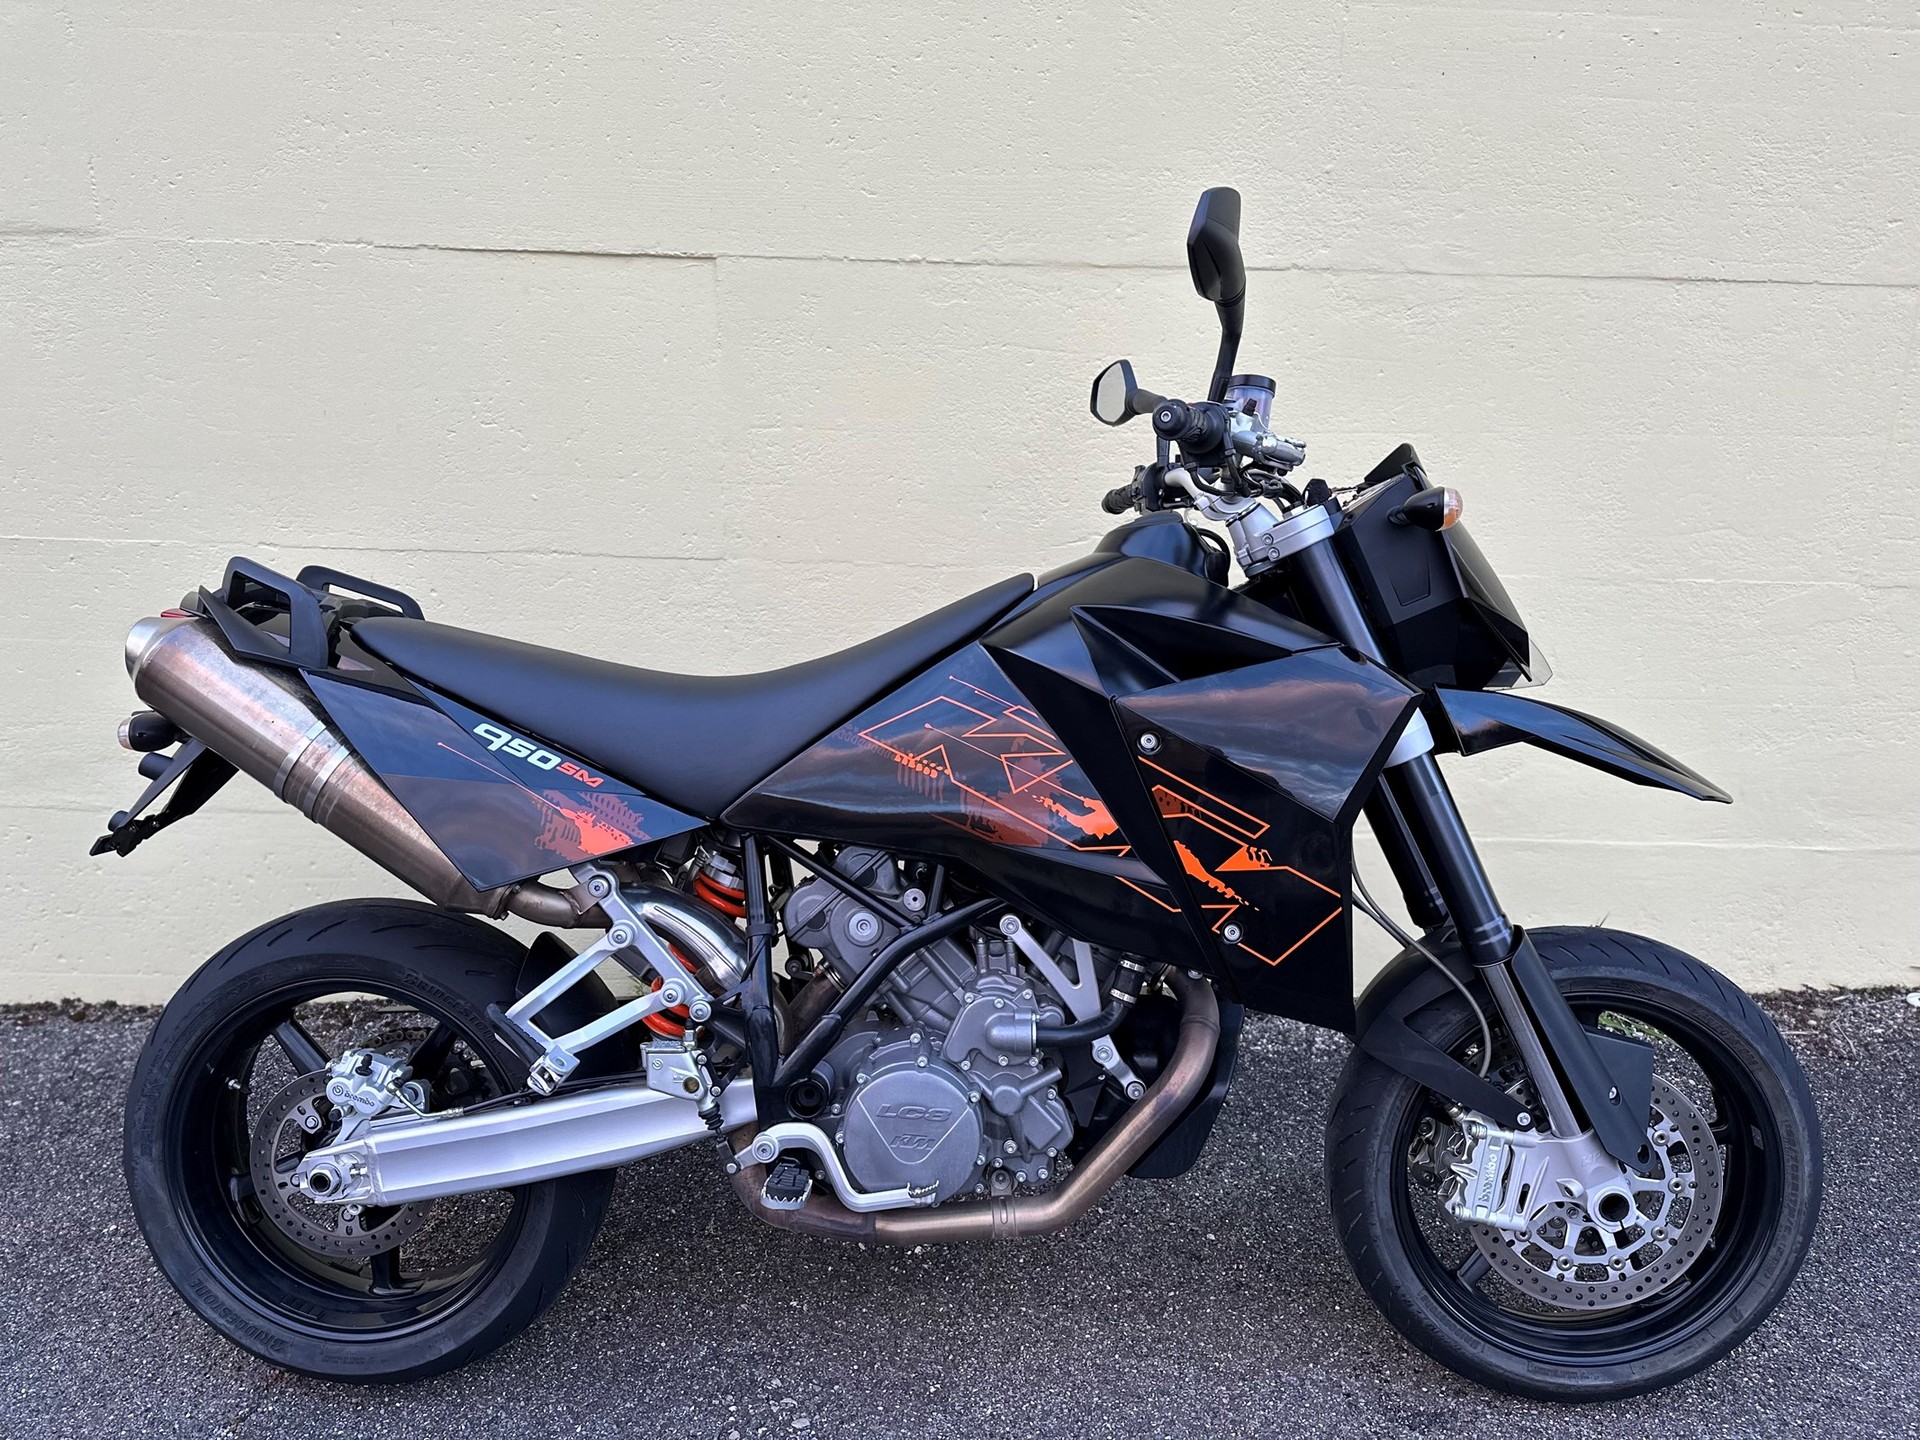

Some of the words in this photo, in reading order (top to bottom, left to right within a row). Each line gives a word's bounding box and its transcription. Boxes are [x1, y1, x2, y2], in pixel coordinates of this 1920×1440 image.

[473, 723, 562, 771] 950
[556, 761, 604, 788] SM
[344, 1090, 375, 1107] brembo
[876, 1103, 952, 1121] LC8
[889, 1133, 936, 1150] KTM
[1478, 1153, 1498, 1202] brembo
[187, 1278, 288, 1351] BRIDGESTONE
